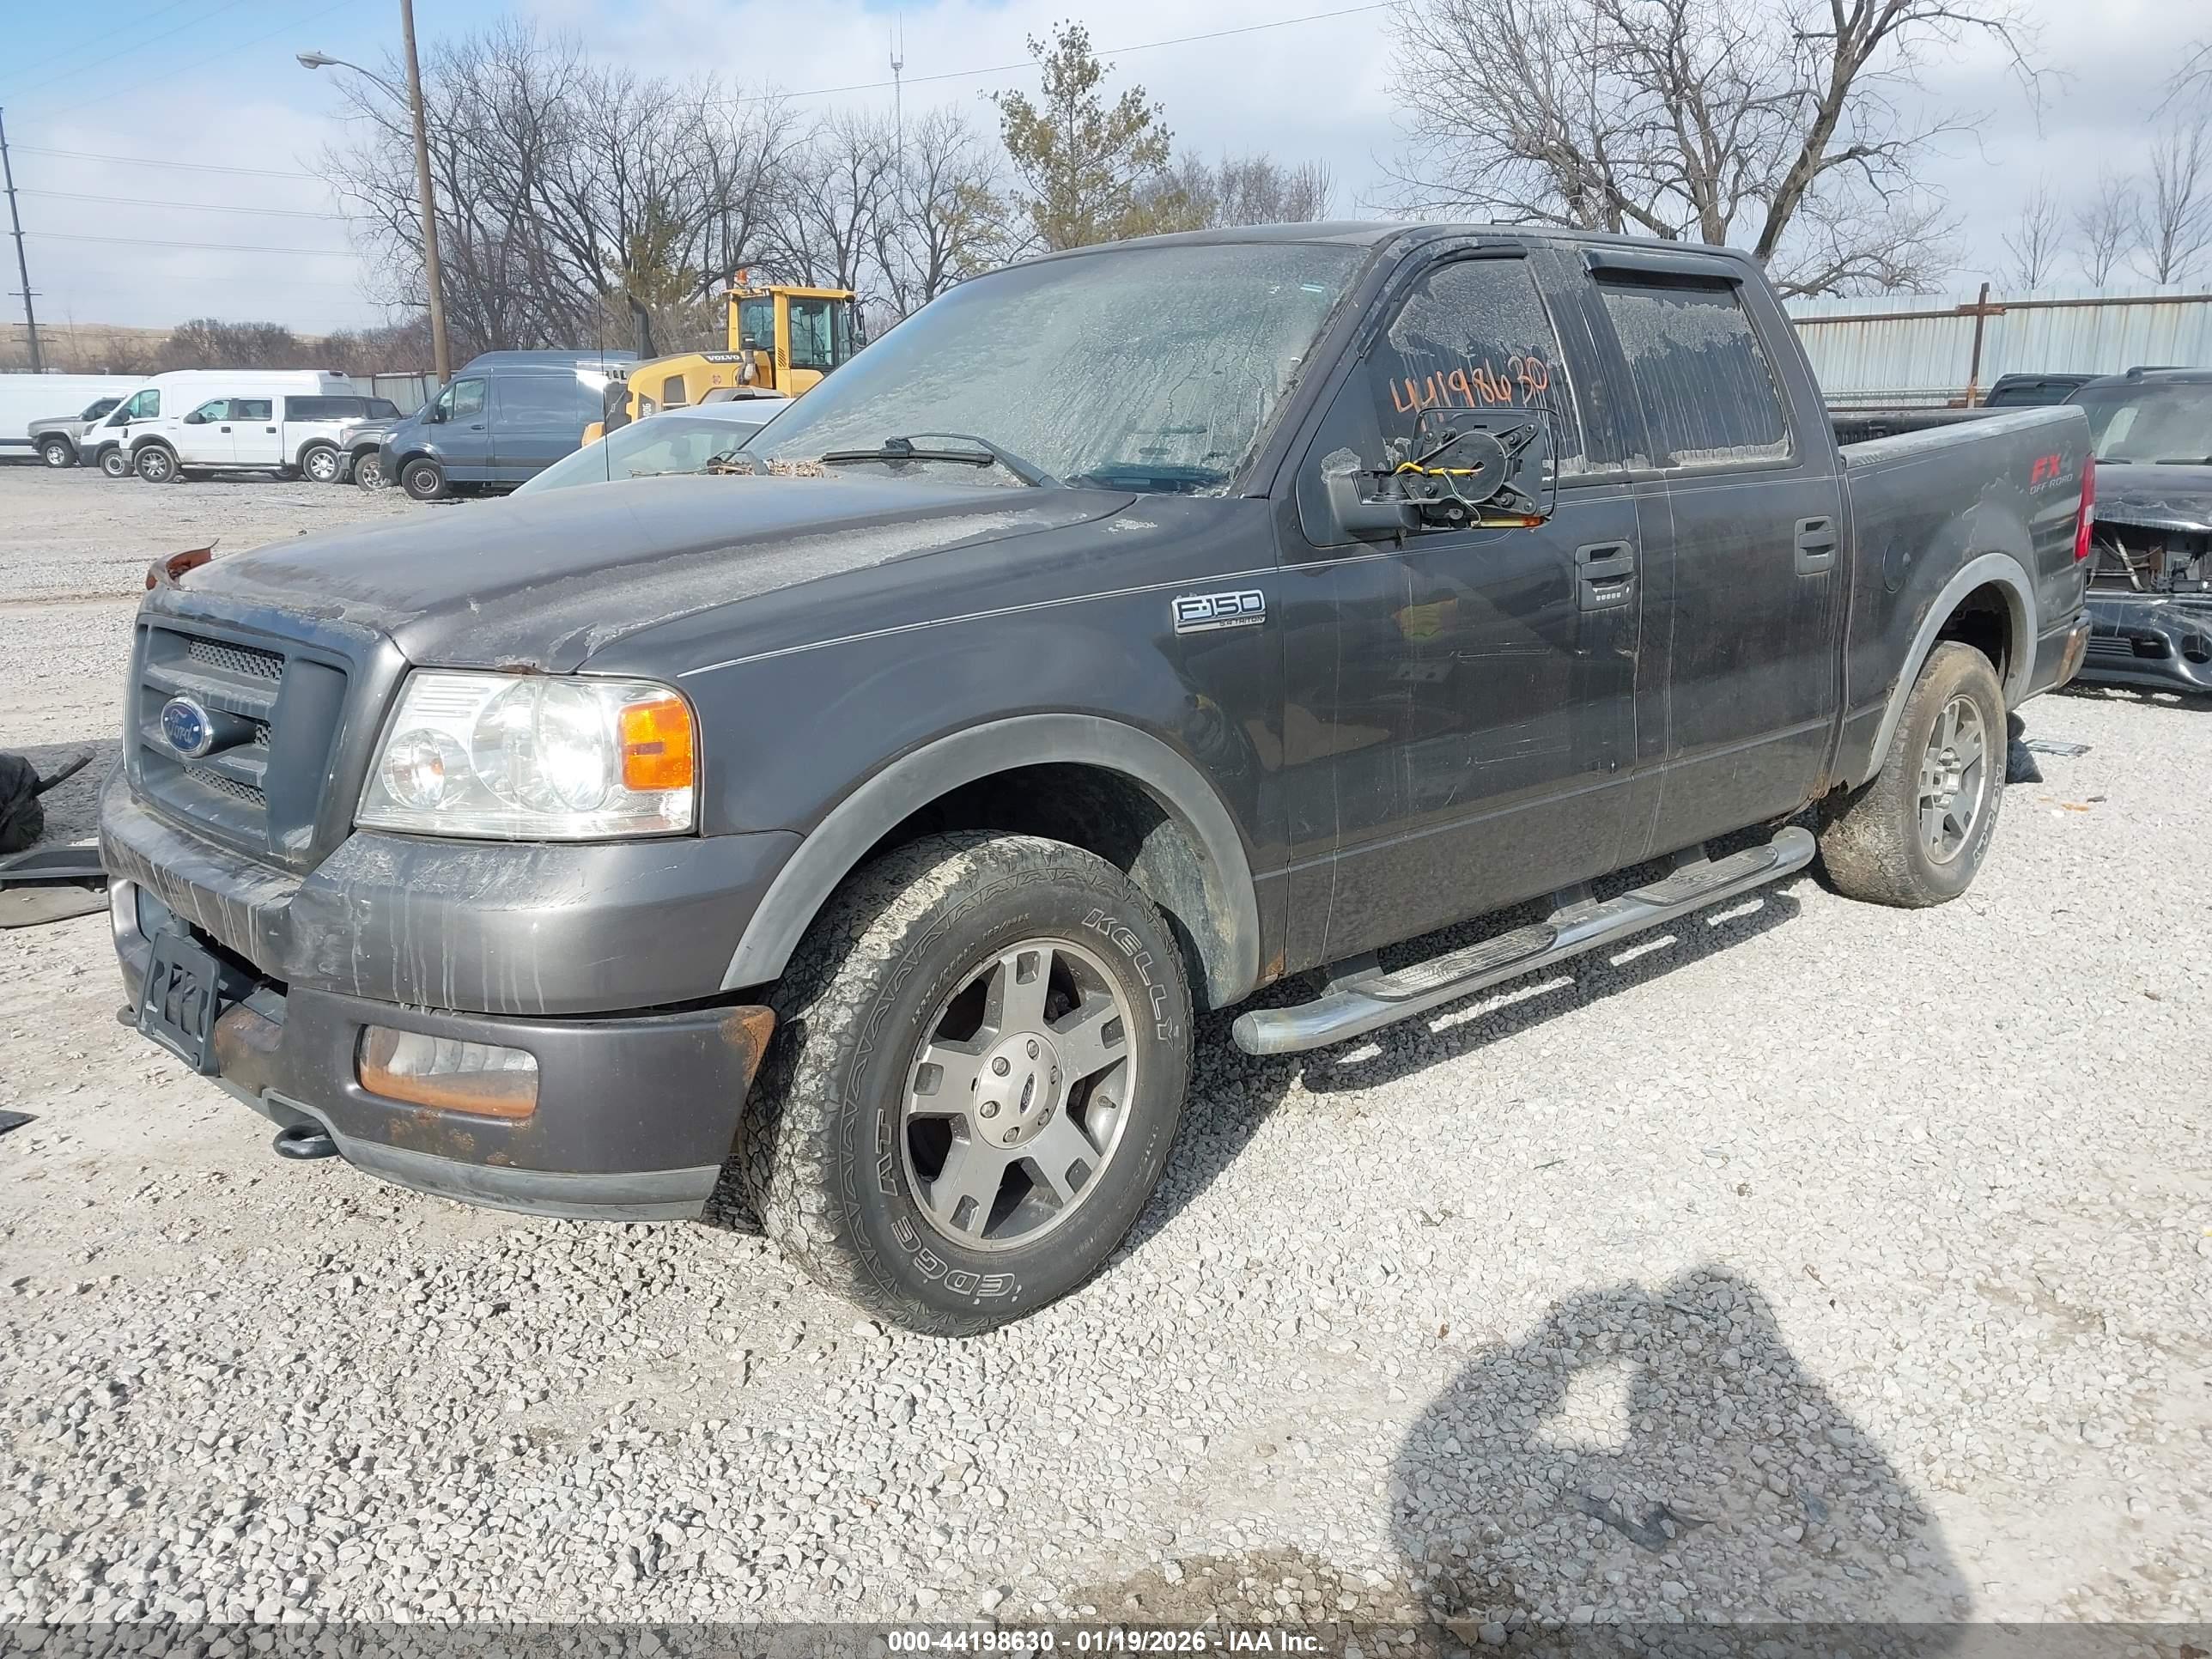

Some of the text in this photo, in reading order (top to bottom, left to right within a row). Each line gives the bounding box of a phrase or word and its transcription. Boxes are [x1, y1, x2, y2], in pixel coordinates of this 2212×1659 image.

[1389, 356, 1548, 432] 44198630
[2029, 473, 2074, 495] OFF ROAD
[1972, 763, 2003, 867] KELLY
[1081, 908, 1174, 1051] KELLY
[875, 1108, 1016, 1297] EDGE AT
